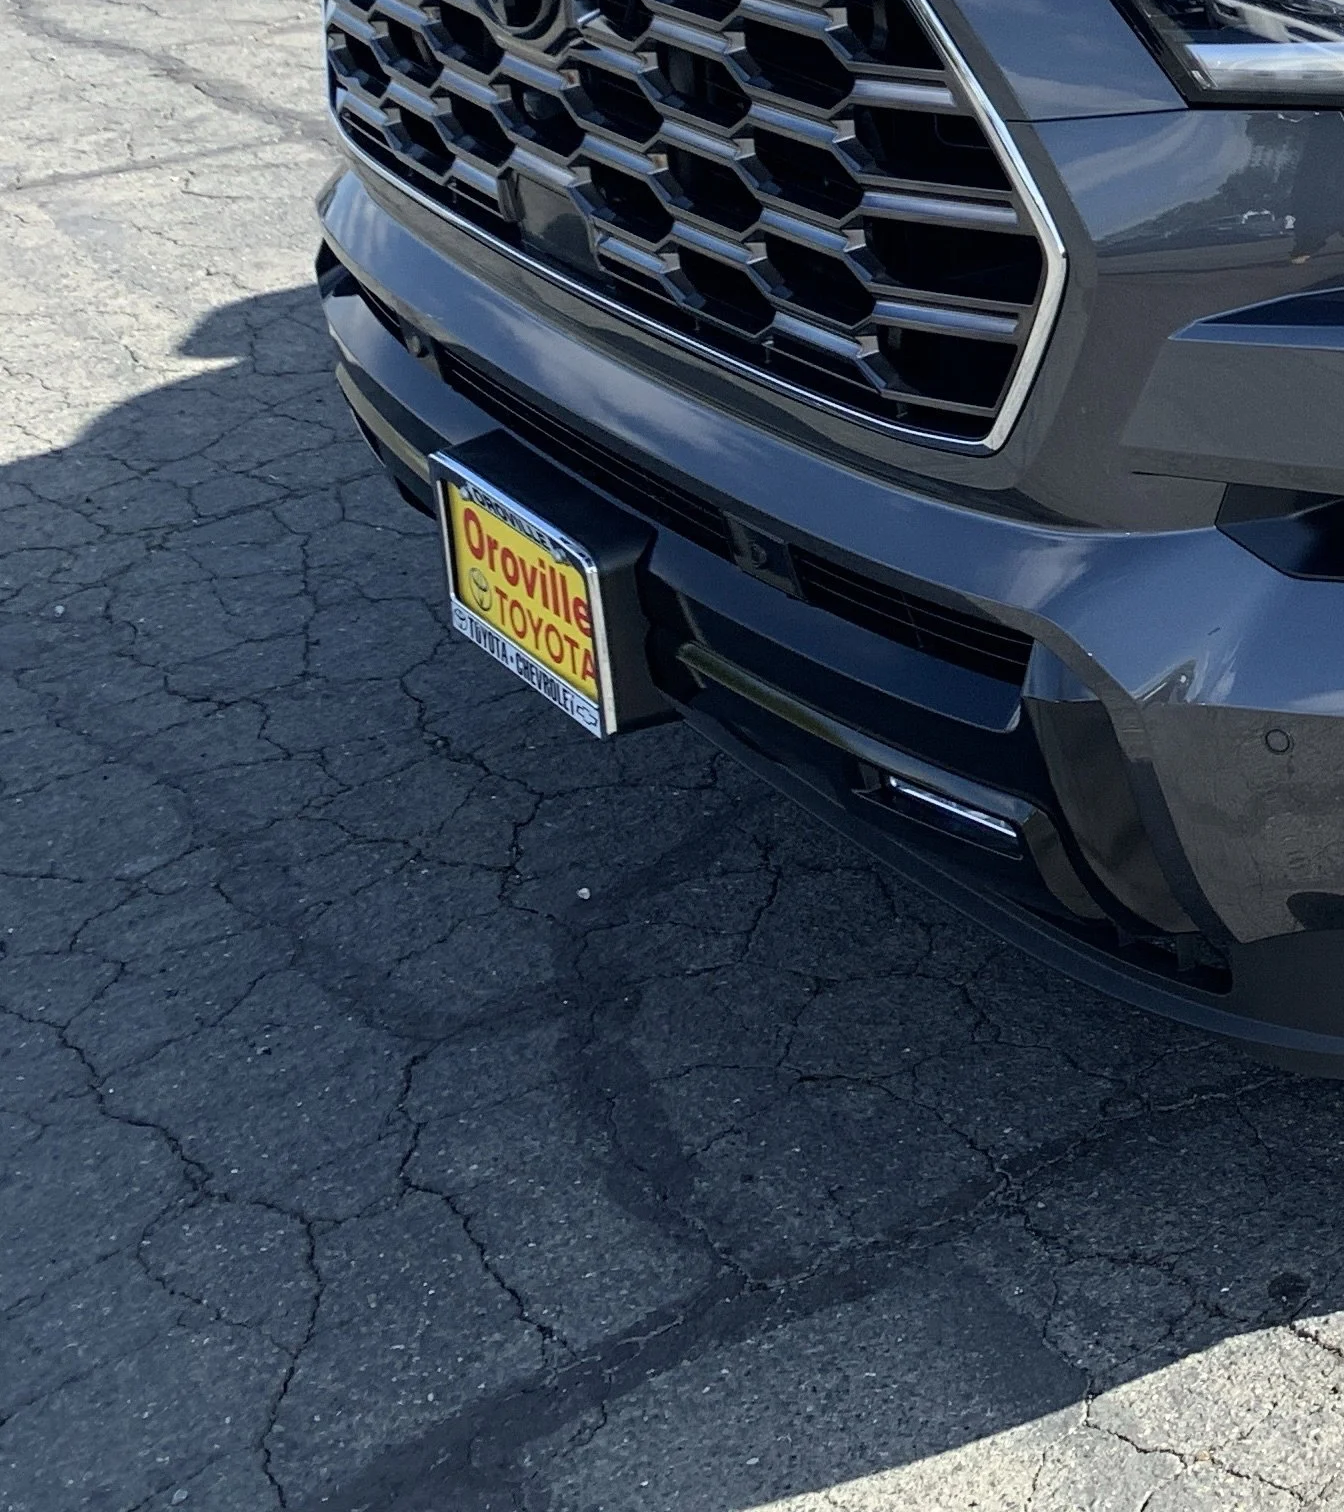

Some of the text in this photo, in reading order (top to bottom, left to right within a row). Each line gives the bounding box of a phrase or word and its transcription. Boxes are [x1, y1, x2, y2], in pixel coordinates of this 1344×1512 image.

[472, 485, 553, 553] OROVILLE
[463, 507, 592, 638] Oroville
[468, 615, 575, 716] TOYOTA CHEVROLET
[495, 587, 596, 682] TOYOTA
